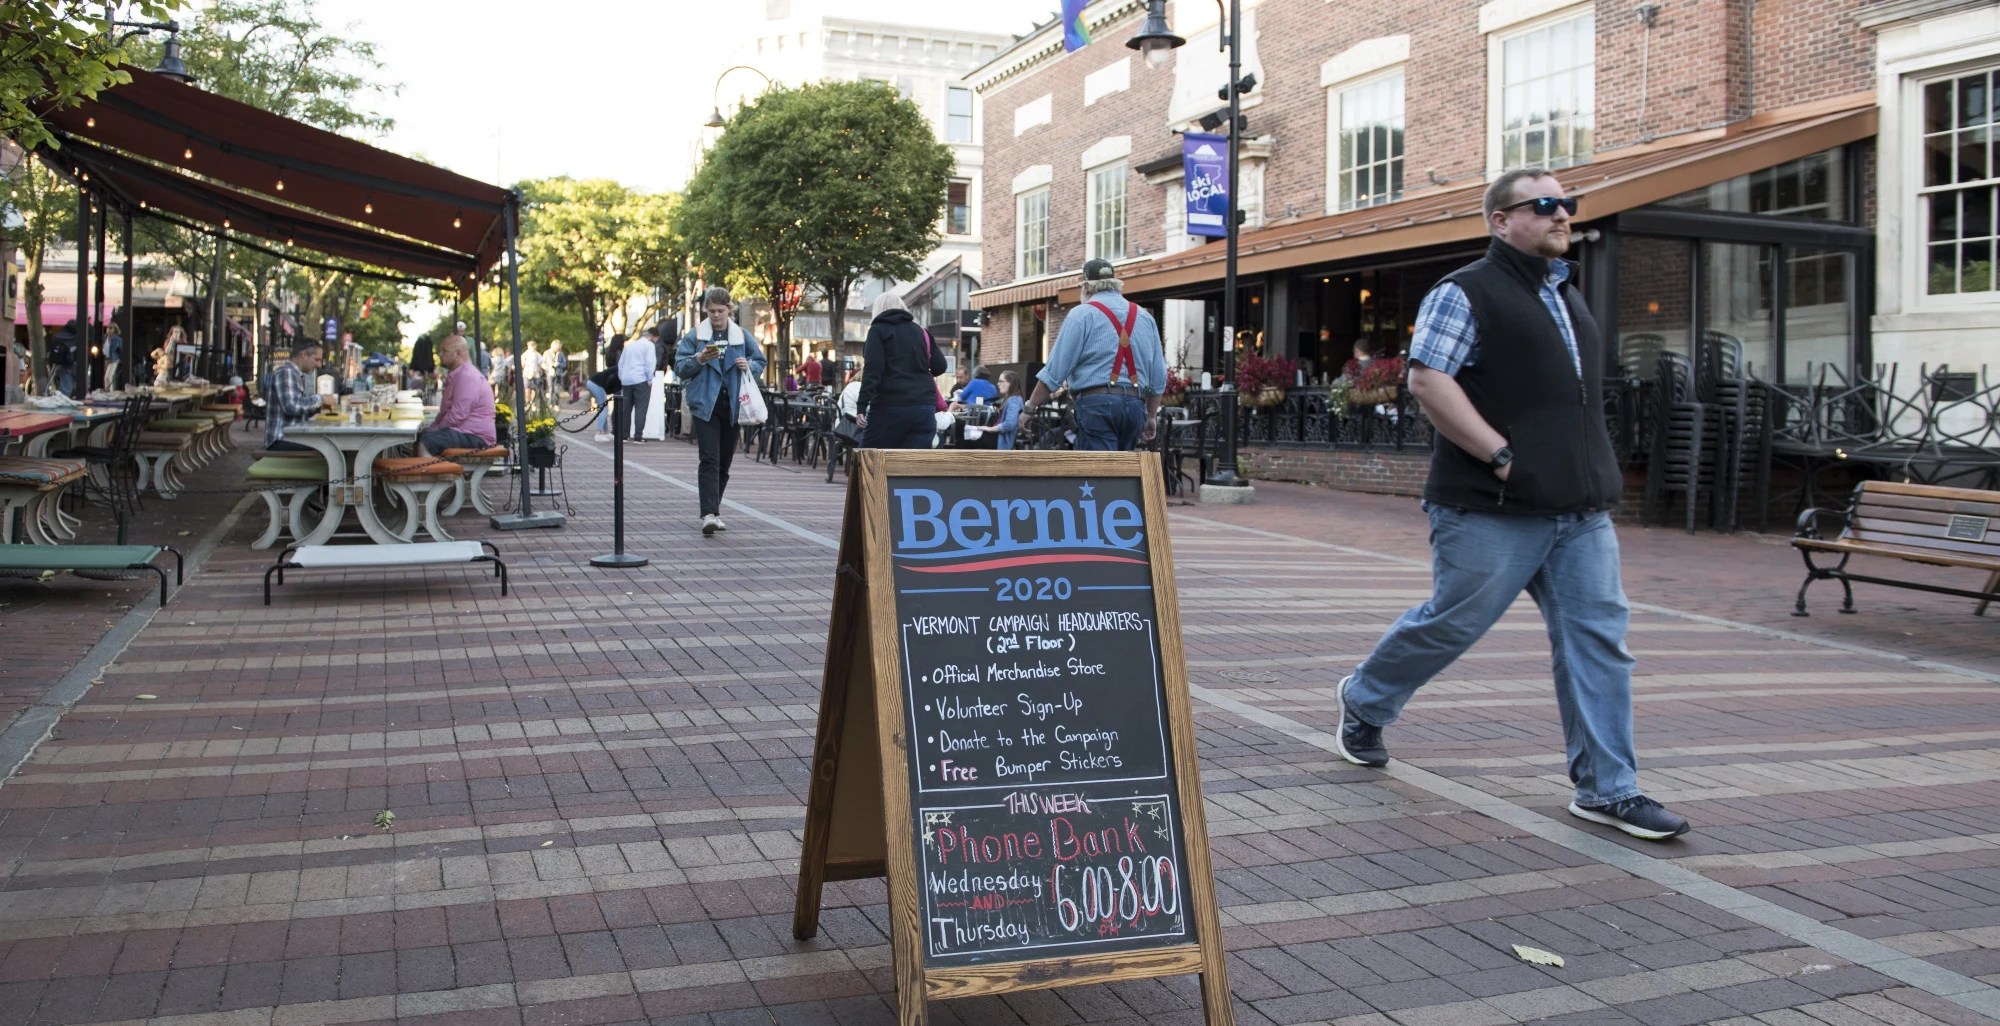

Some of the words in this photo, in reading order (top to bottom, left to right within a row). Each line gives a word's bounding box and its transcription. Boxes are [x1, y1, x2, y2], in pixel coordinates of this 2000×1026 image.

[1187, 183, 1226, 202] LOCAL
[1191, 173, 1211, 191] ski
[893, 480, 1144, 549] Bernie
[995, 577, 1072, 602] 2020
[912, 615, 980, 636] VERMONT
[989, 613, 1050, 633] CAMPAIGN
[1058, 611, 1144, 632] HEADQUARTERS
[932, 664, 980, 684] Official
[987, 660, 1061, 682] Merchandise
[1067, 657, 1106, 676] Store
[935, 695, 1008, 721] Volunteer
[1017, 691, 1083, 721] Sign-Up
[939, 729, 990, 753] Donate
[997, 730, 1013, 747] to
[1021, 728, 1046, 746] the
[1054, 725, 1119, 751] Campaign
[940, 759, 979, 783] Free
[995, 756, 1051, 781] Bumper
[1059, 750, 1123, 771] Stickers
[1003, 791, 1039, 815] THIS
[1040, 793, 1092, 815] WEEK
[936, 825, 1042, 864] Phone
[1050, 816, 1147, 861] Bank
[930, 868, 1042, 897] Wednesday
[972, 894, 1006, 910] AND
[932, 917, 1030, 948] Thursday
